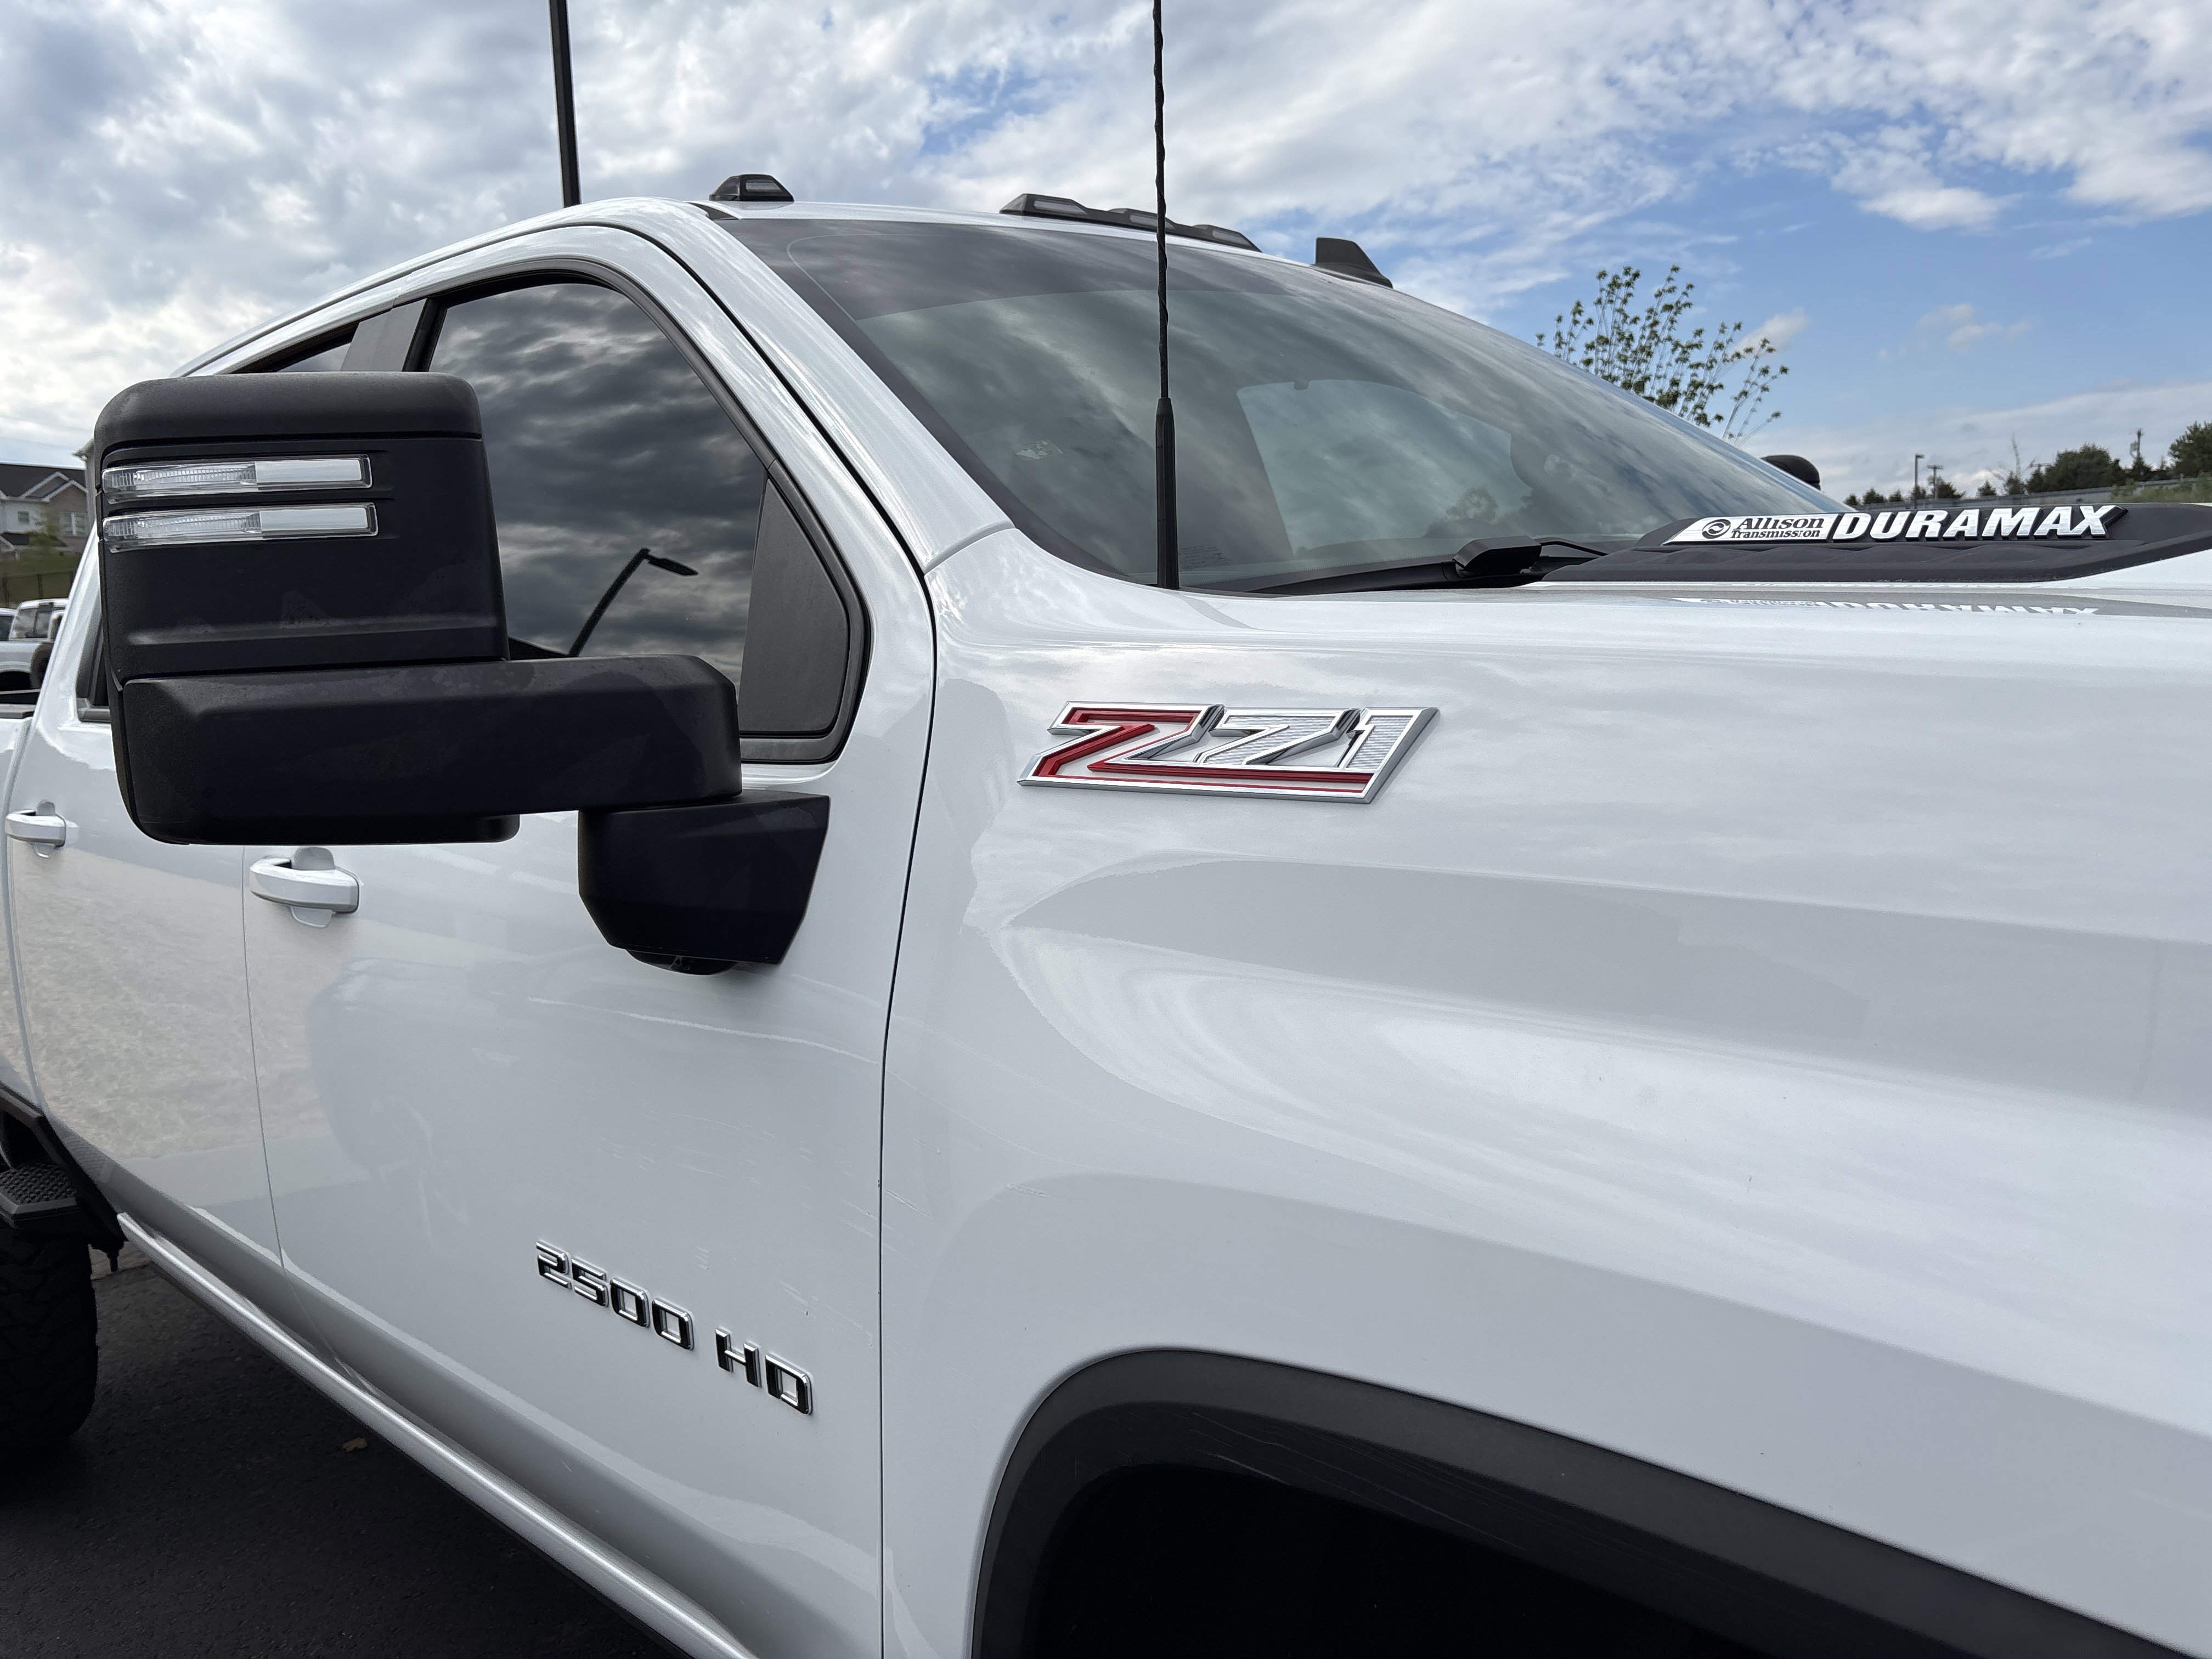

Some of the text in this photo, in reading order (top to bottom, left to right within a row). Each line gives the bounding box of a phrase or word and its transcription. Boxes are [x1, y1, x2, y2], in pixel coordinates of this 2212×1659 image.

[1730, 529, 1821, 539] Transmission
[1733, 517, 1825, 530] Allison
[1832, 505, 2124, 541] DURAMAX
[1017, 701, 1440, 804] Z71
[536, 1240, 814, 1415] 2500 HD
